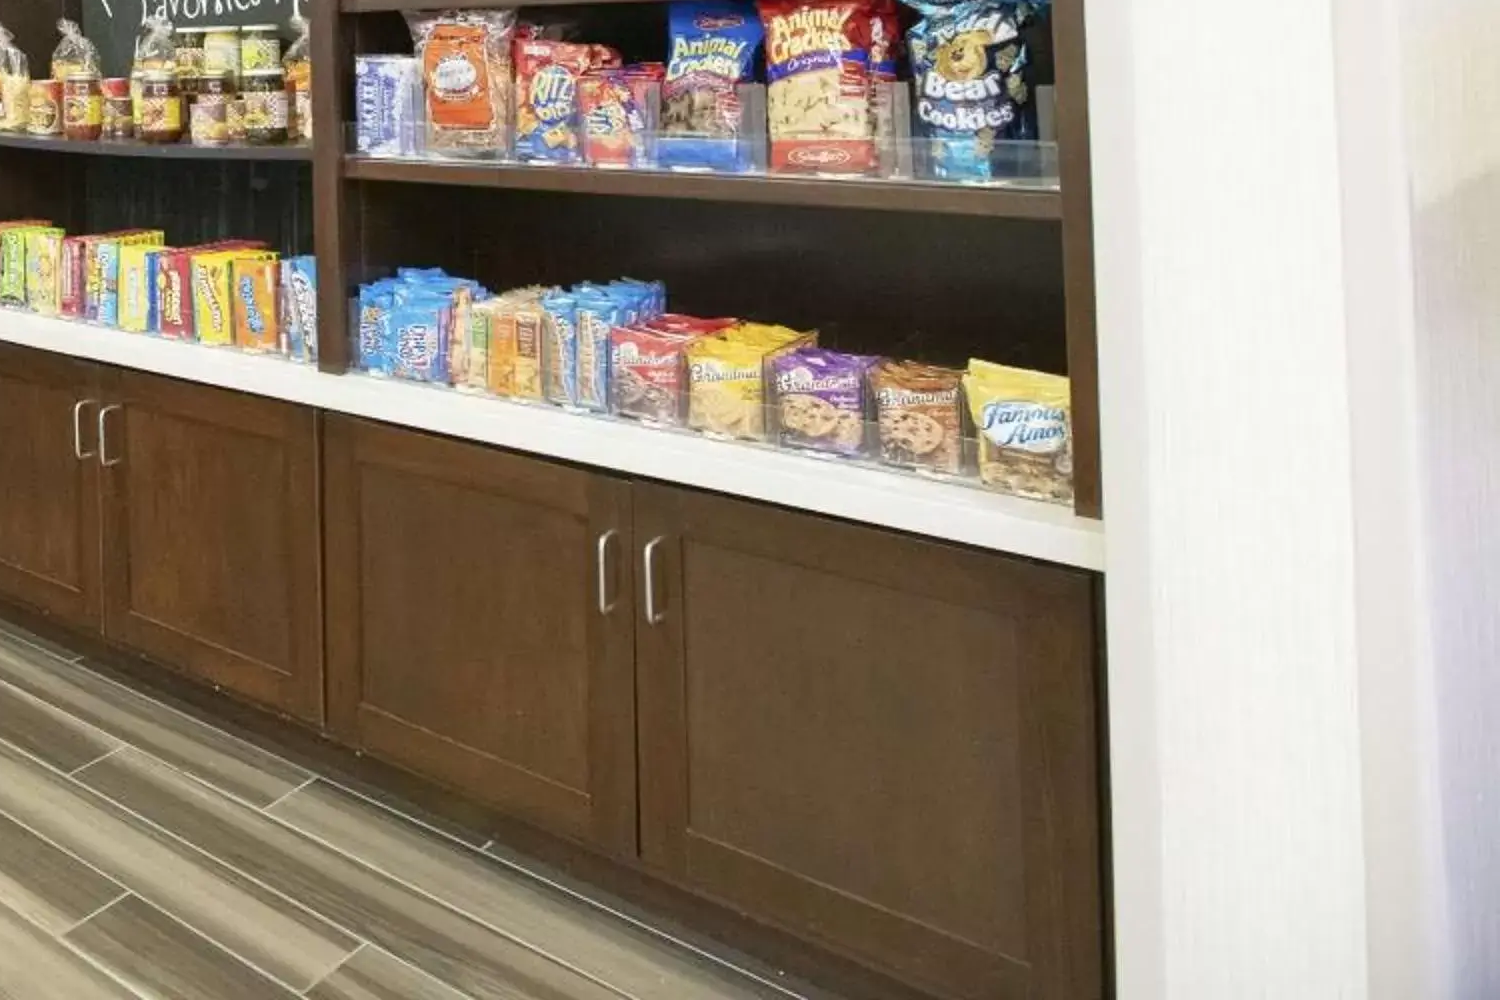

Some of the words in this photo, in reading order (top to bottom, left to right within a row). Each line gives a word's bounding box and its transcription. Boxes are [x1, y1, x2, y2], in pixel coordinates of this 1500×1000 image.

[771, 4, 857, 38] Animal
[671, 32, 749, 61] Animal
[923, 71, 1002, 102] Bear
[917, 101, 1016, 130] Cookies
[982, 403, 1066, 431] Famous
[1000, 424, 1066, 447] Amos
